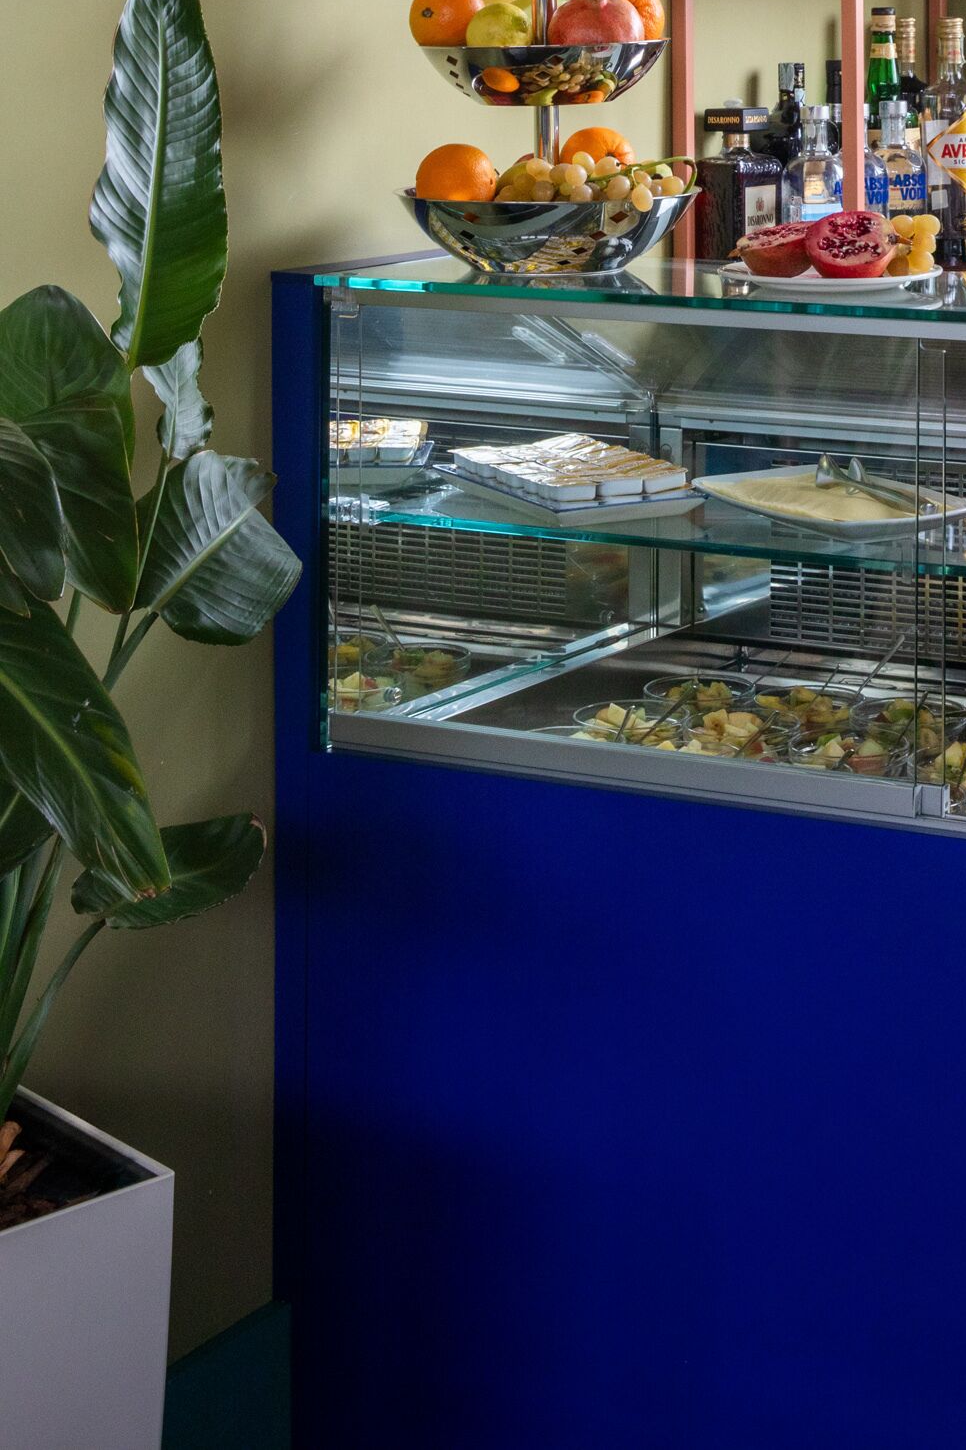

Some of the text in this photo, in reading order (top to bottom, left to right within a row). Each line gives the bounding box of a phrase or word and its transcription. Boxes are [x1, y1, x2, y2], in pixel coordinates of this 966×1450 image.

[707, 116, 740, 124] DISARONNO
[893, 171, 927, 188] ABSO
[900, 187, 927, 201] VOD
[747, 213, 774, 227] DISARONNO
